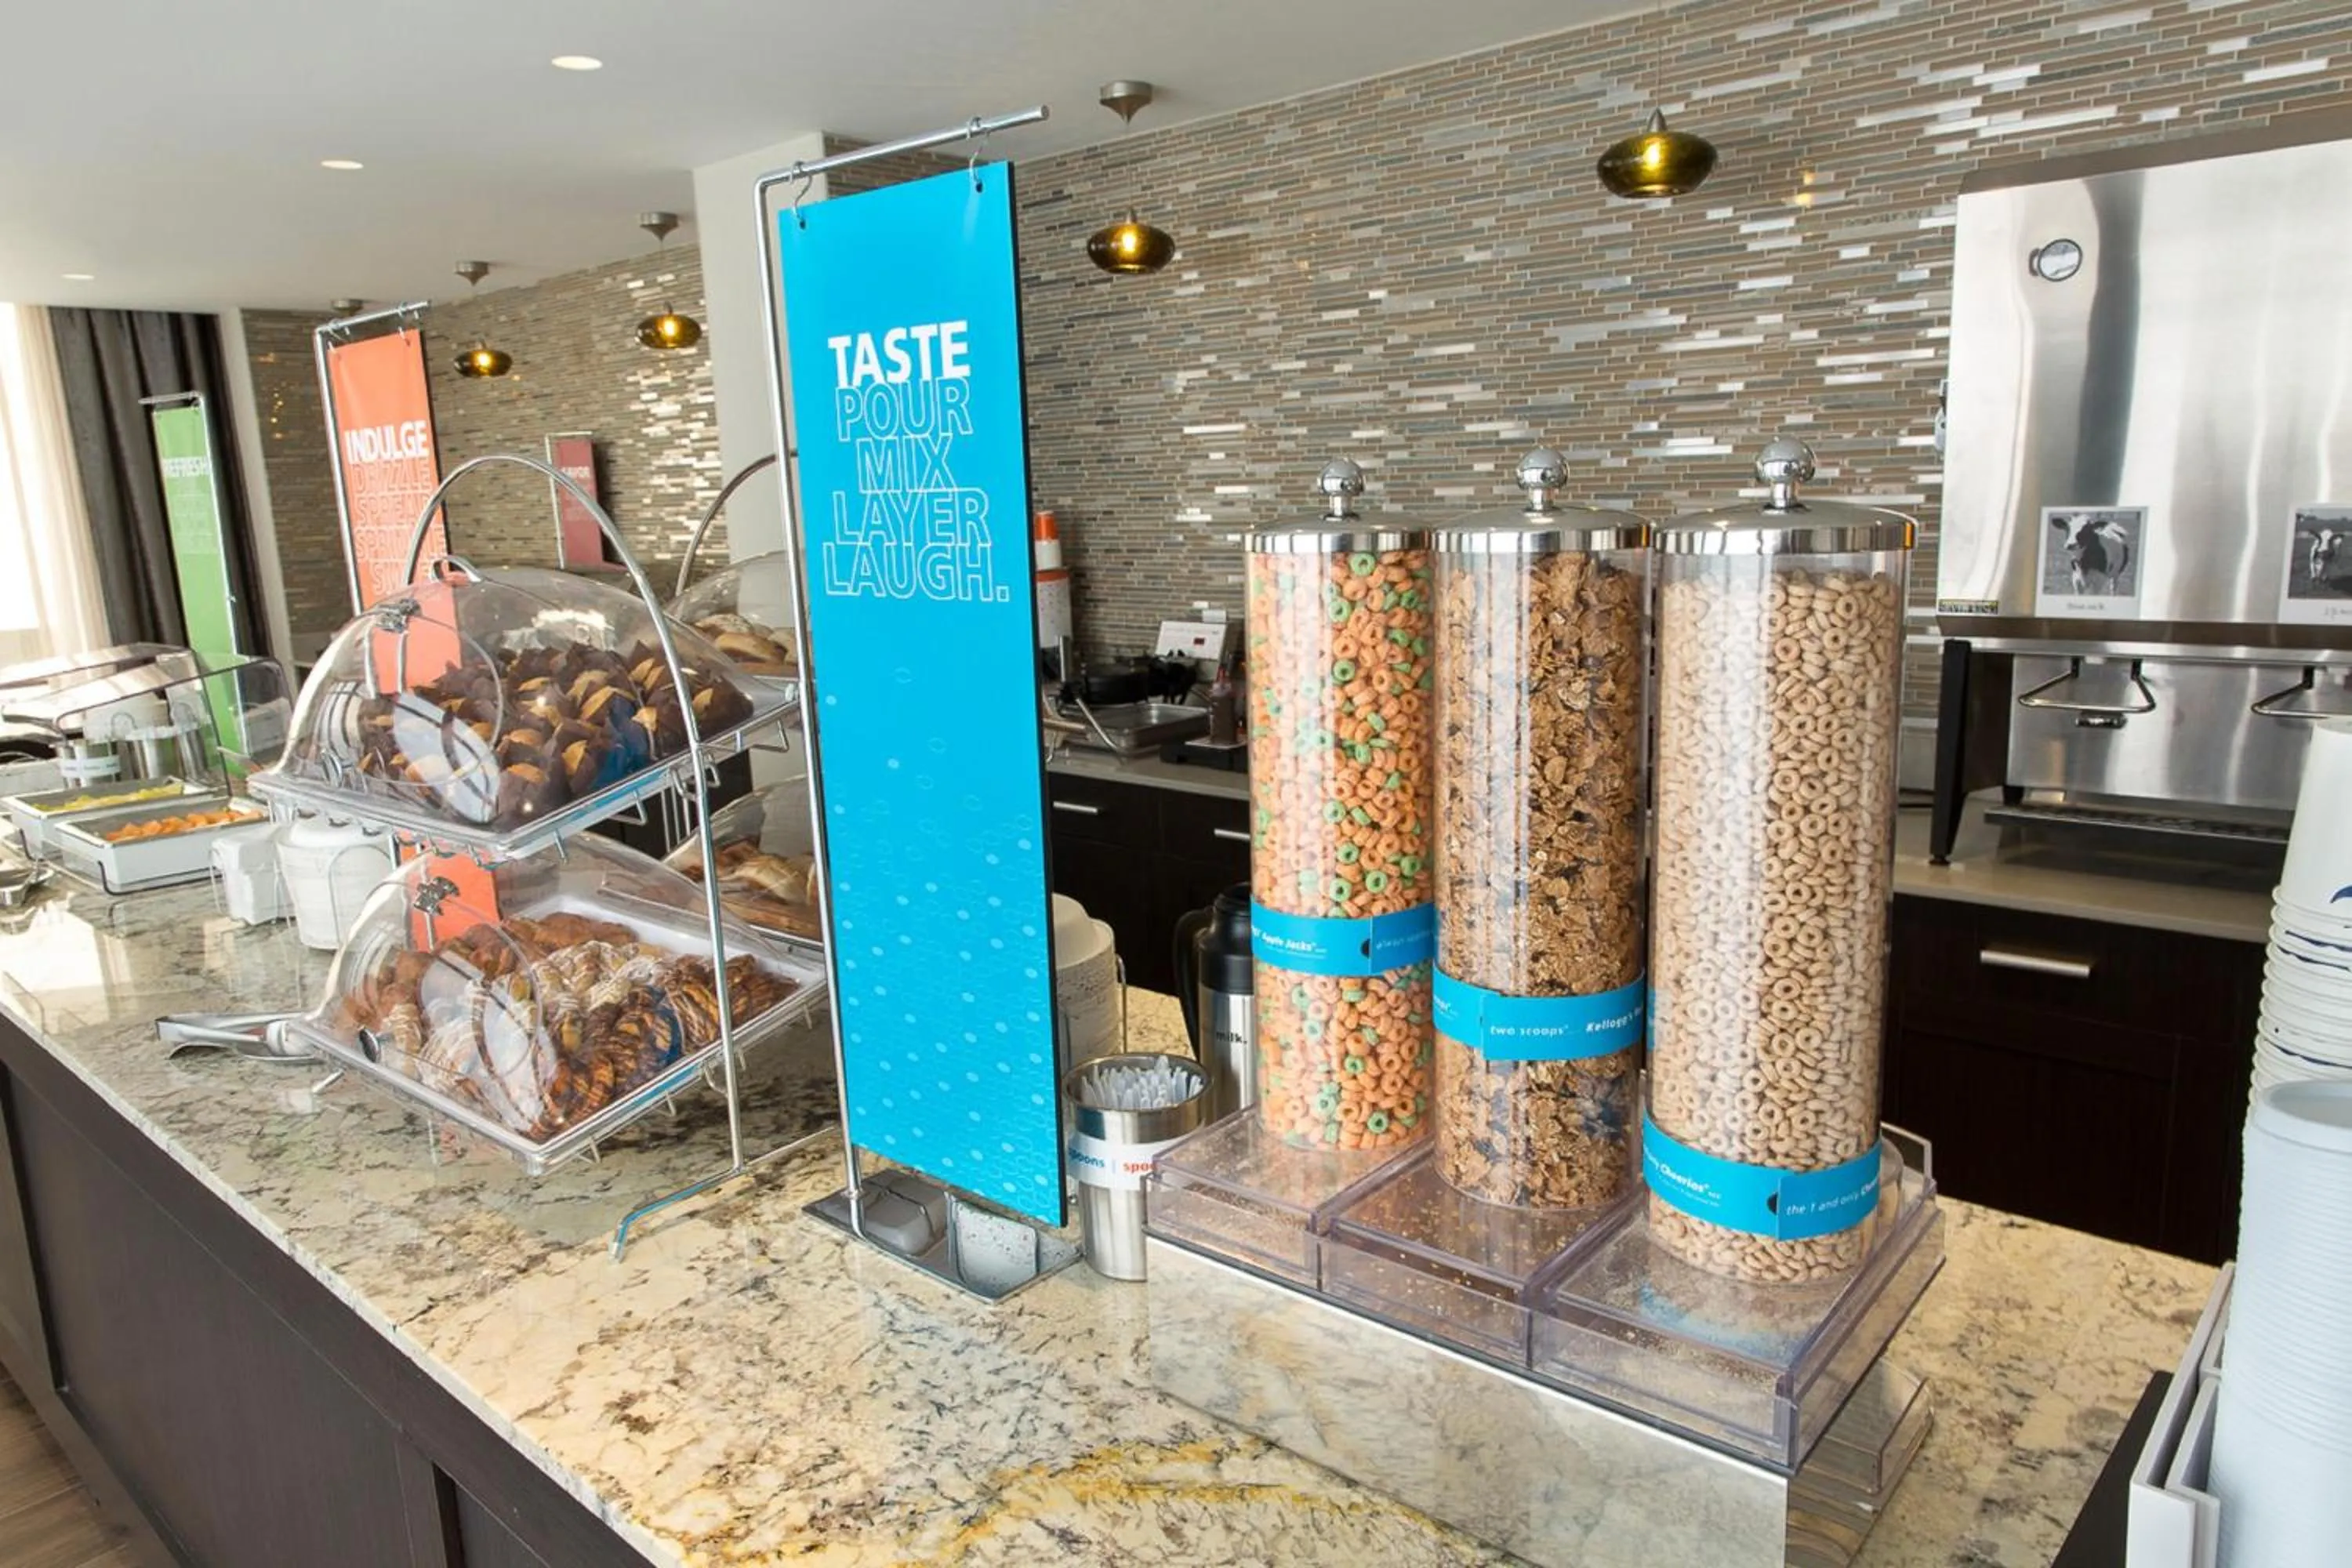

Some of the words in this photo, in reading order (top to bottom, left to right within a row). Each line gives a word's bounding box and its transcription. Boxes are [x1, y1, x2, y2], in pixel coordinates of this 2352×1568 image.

[828, 320, 971, 389] TASTE
[835, 376, 973, 442] POUR
[345, 420, 430, 464] INDULGE
[857, 432, 957, 493] MIX
[833, 488, 992, 546] LAYER
[822, 543, 1011, 603] LAUGH.
[1285, 937, 1312, 953] Jacks
[1490, 1025, 1515, 1036] two
[1519, 1026, 1564, 1038] scoops
[1786, 1204, 1806, 1215] the
[1818, 1197, 1839, 1211] and
